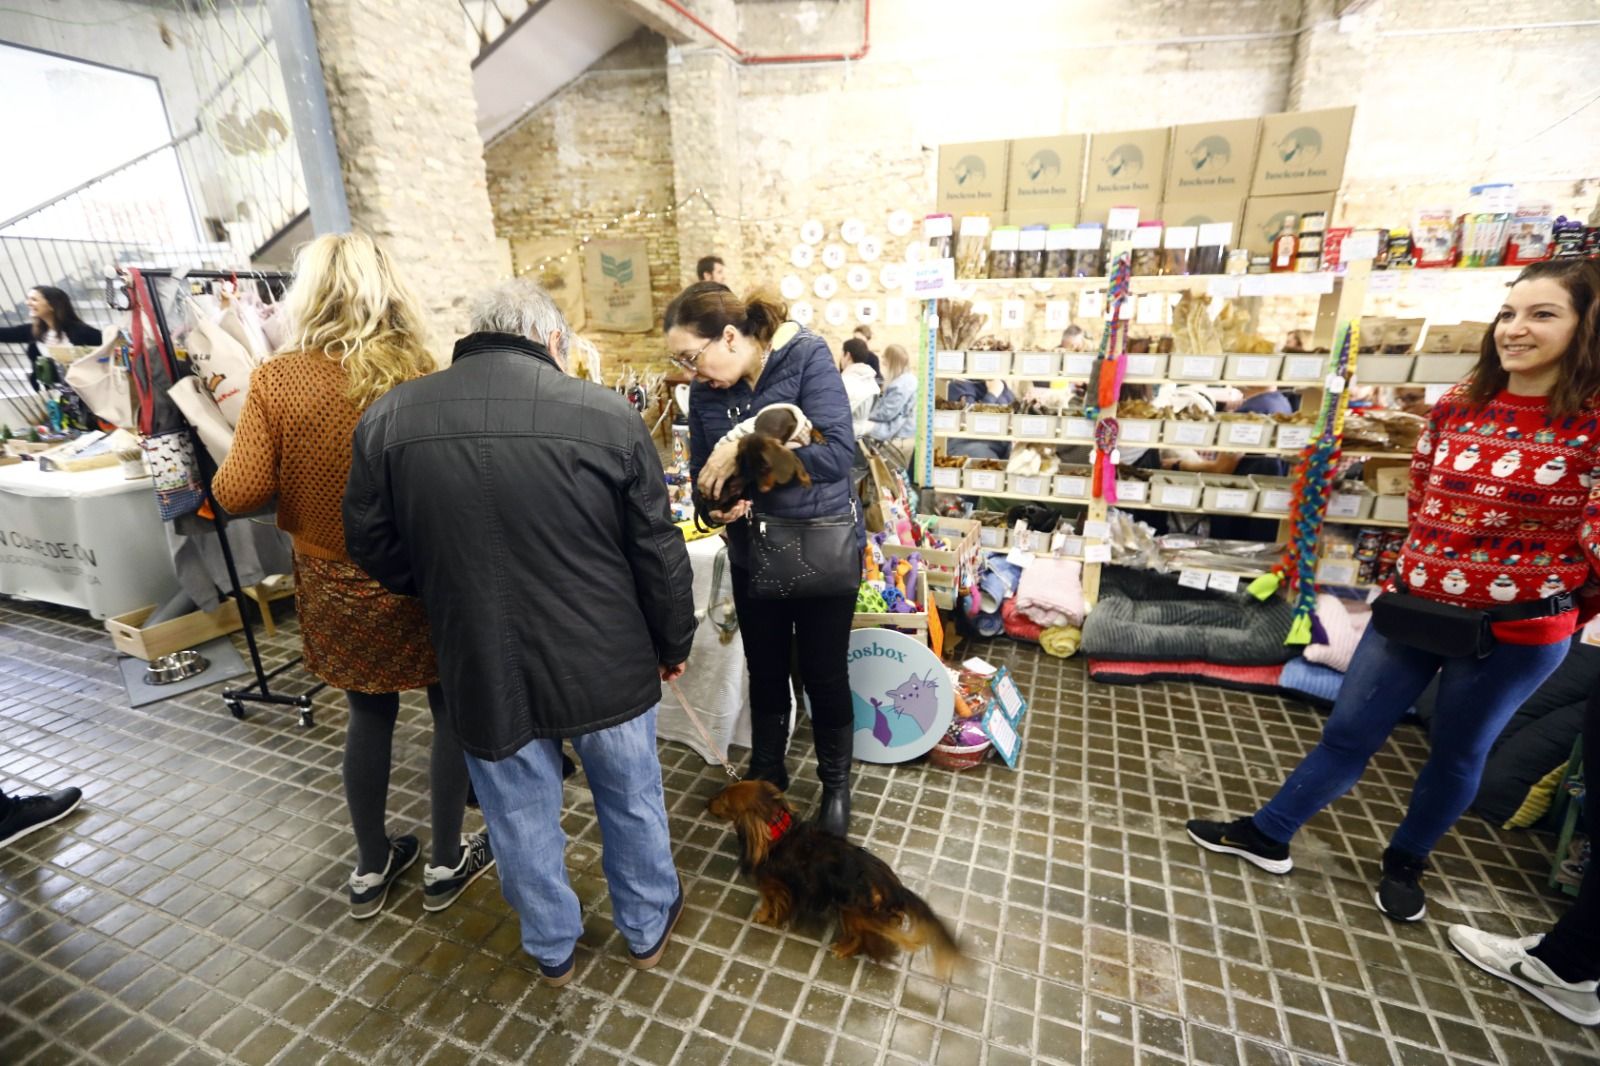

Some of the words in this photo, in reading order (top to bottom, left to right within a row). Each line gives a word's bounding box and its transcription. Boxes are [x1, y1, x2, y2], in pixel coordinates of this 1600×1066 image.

[1473, 482, 1506, 498] HO!
[1548, 494, 1585, 506] HO!
[1472, 536, 1547, 553] TEAM
